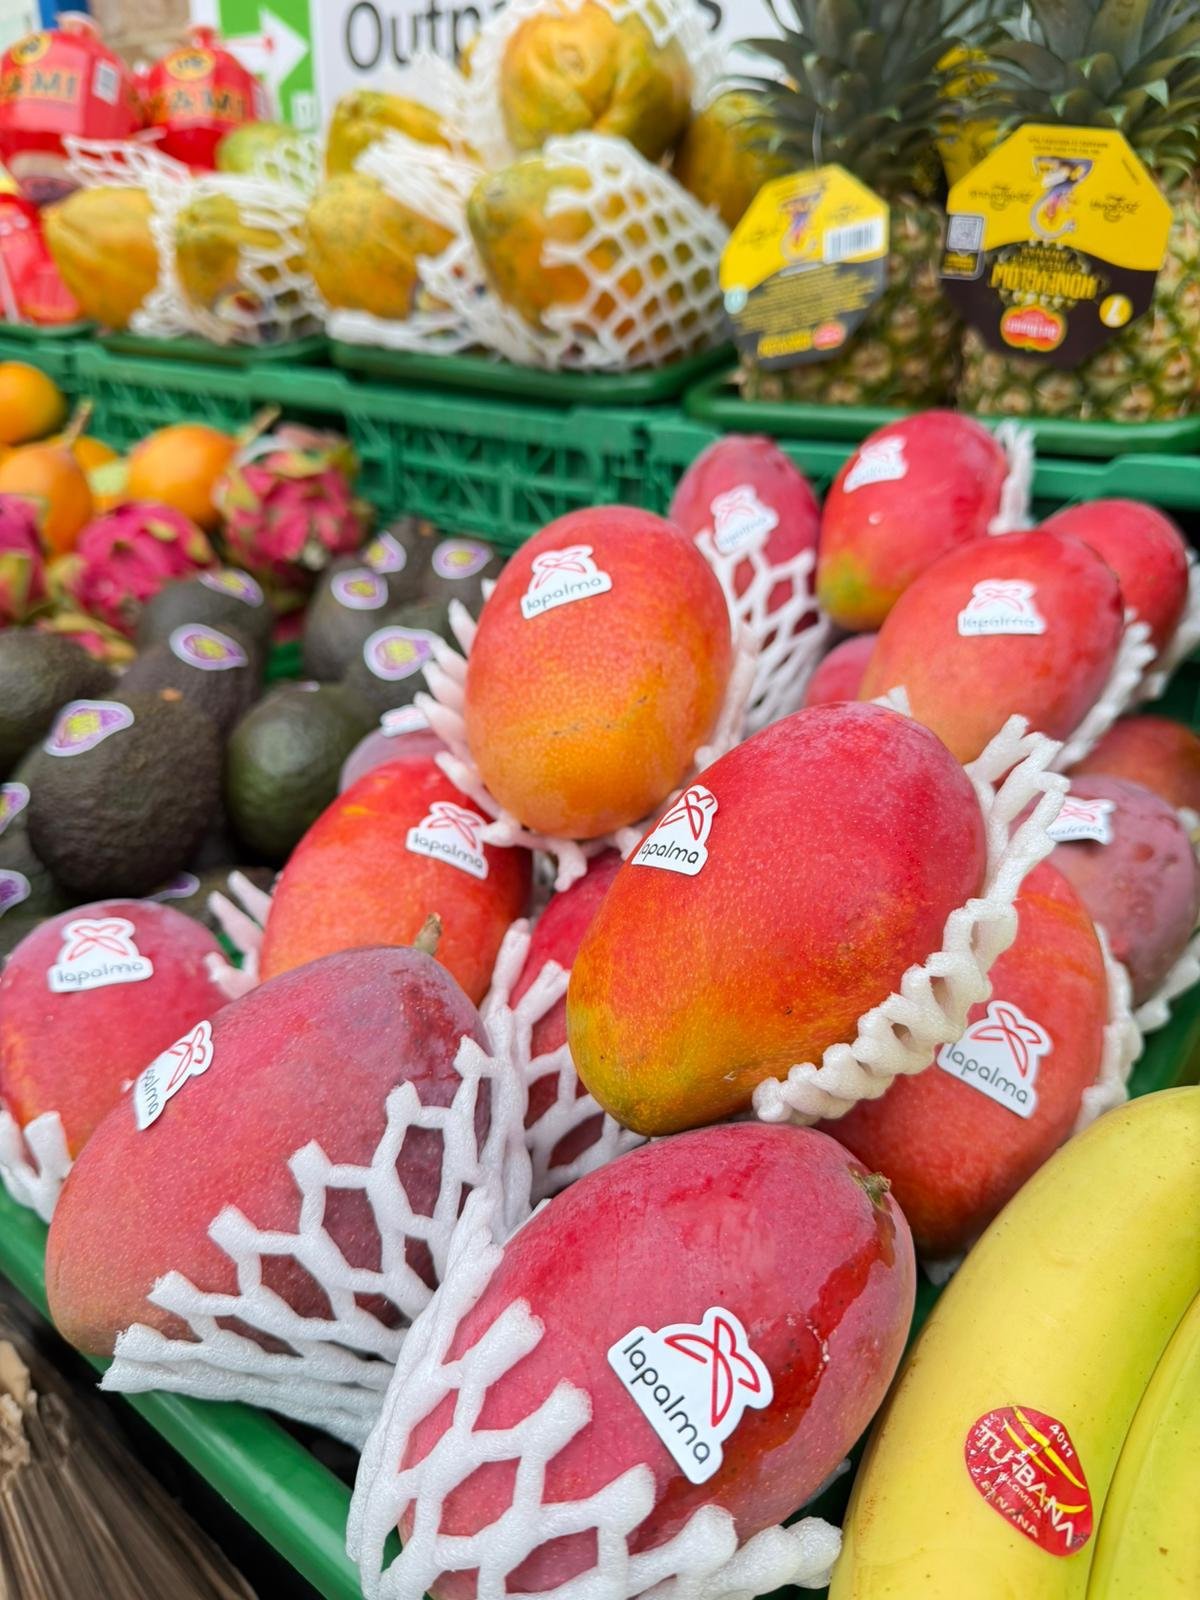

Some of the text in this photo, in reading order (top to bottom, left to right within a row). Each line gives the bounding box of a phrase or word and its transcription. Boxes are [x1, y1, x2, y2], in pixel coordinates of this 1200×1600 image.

[345, 0, 509, 70] Outp
[526, 577, 602, 612] lapalma
[963, 616, 1036, 633] lapalma
[413, 831, 483, 870] lapalma
[640, 839, 699, 865] apalma
[58, 961, 144, 985] lapalma
[945, 1043, 1028, 1105] lapalma
[622, 1335, 711, 1465] lapalma
[1048, 1423, 1074, 1459] 4011
[975, 1423, 1075, 1547] TURBANA
